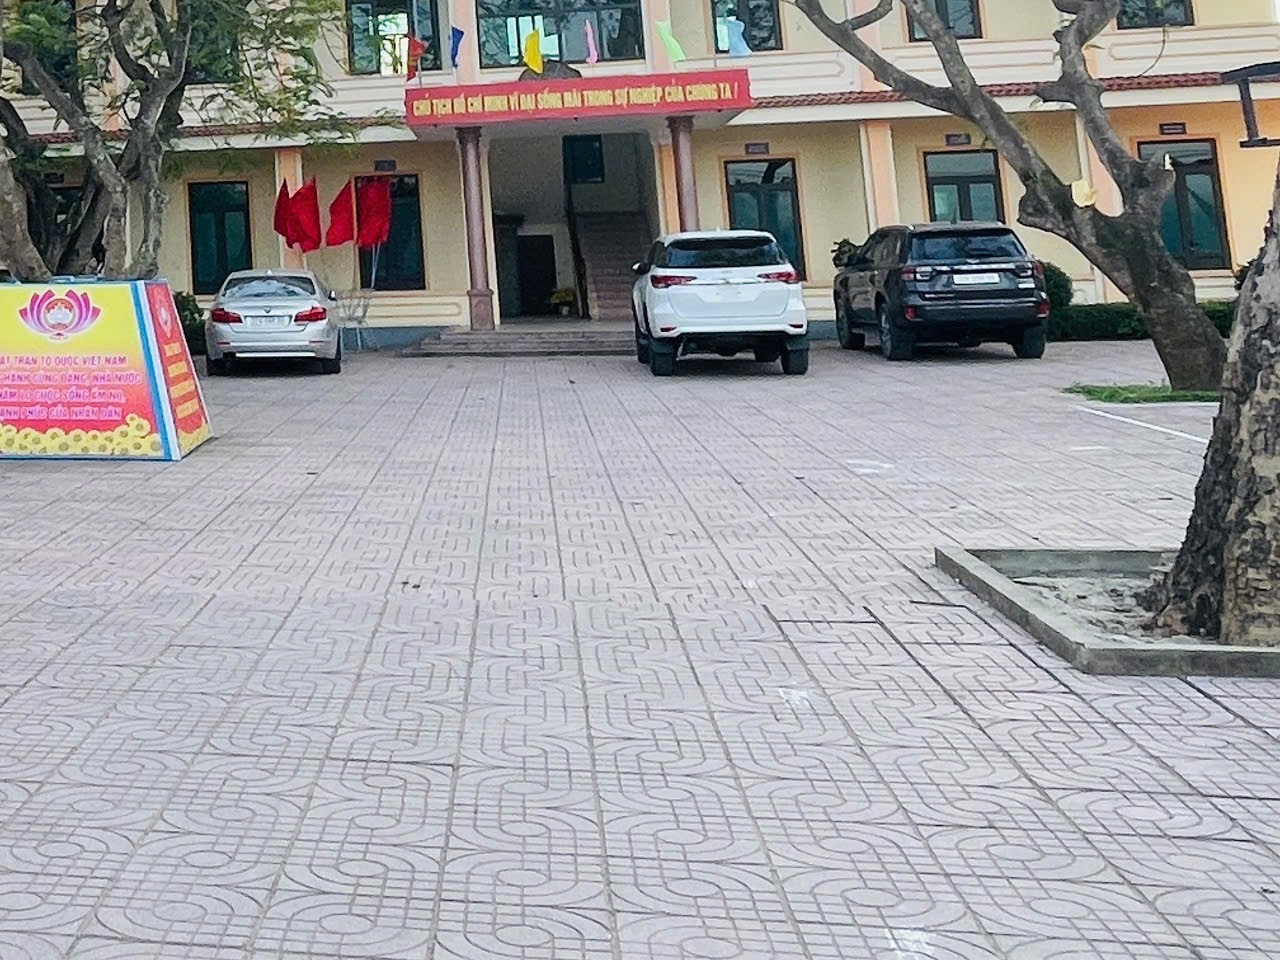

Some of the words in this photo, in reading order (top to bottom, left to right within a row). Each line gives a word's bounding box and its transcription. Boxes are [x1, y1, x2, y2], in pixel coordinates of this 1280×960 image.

[582, 90, 613, 107] TRONG
[629, 83, 662, 107] NGHIỆP
[665, 78, 684, 102] CỦA
[718, 82, 732, 100] TA
[105, 355, 127, 366] NAM
